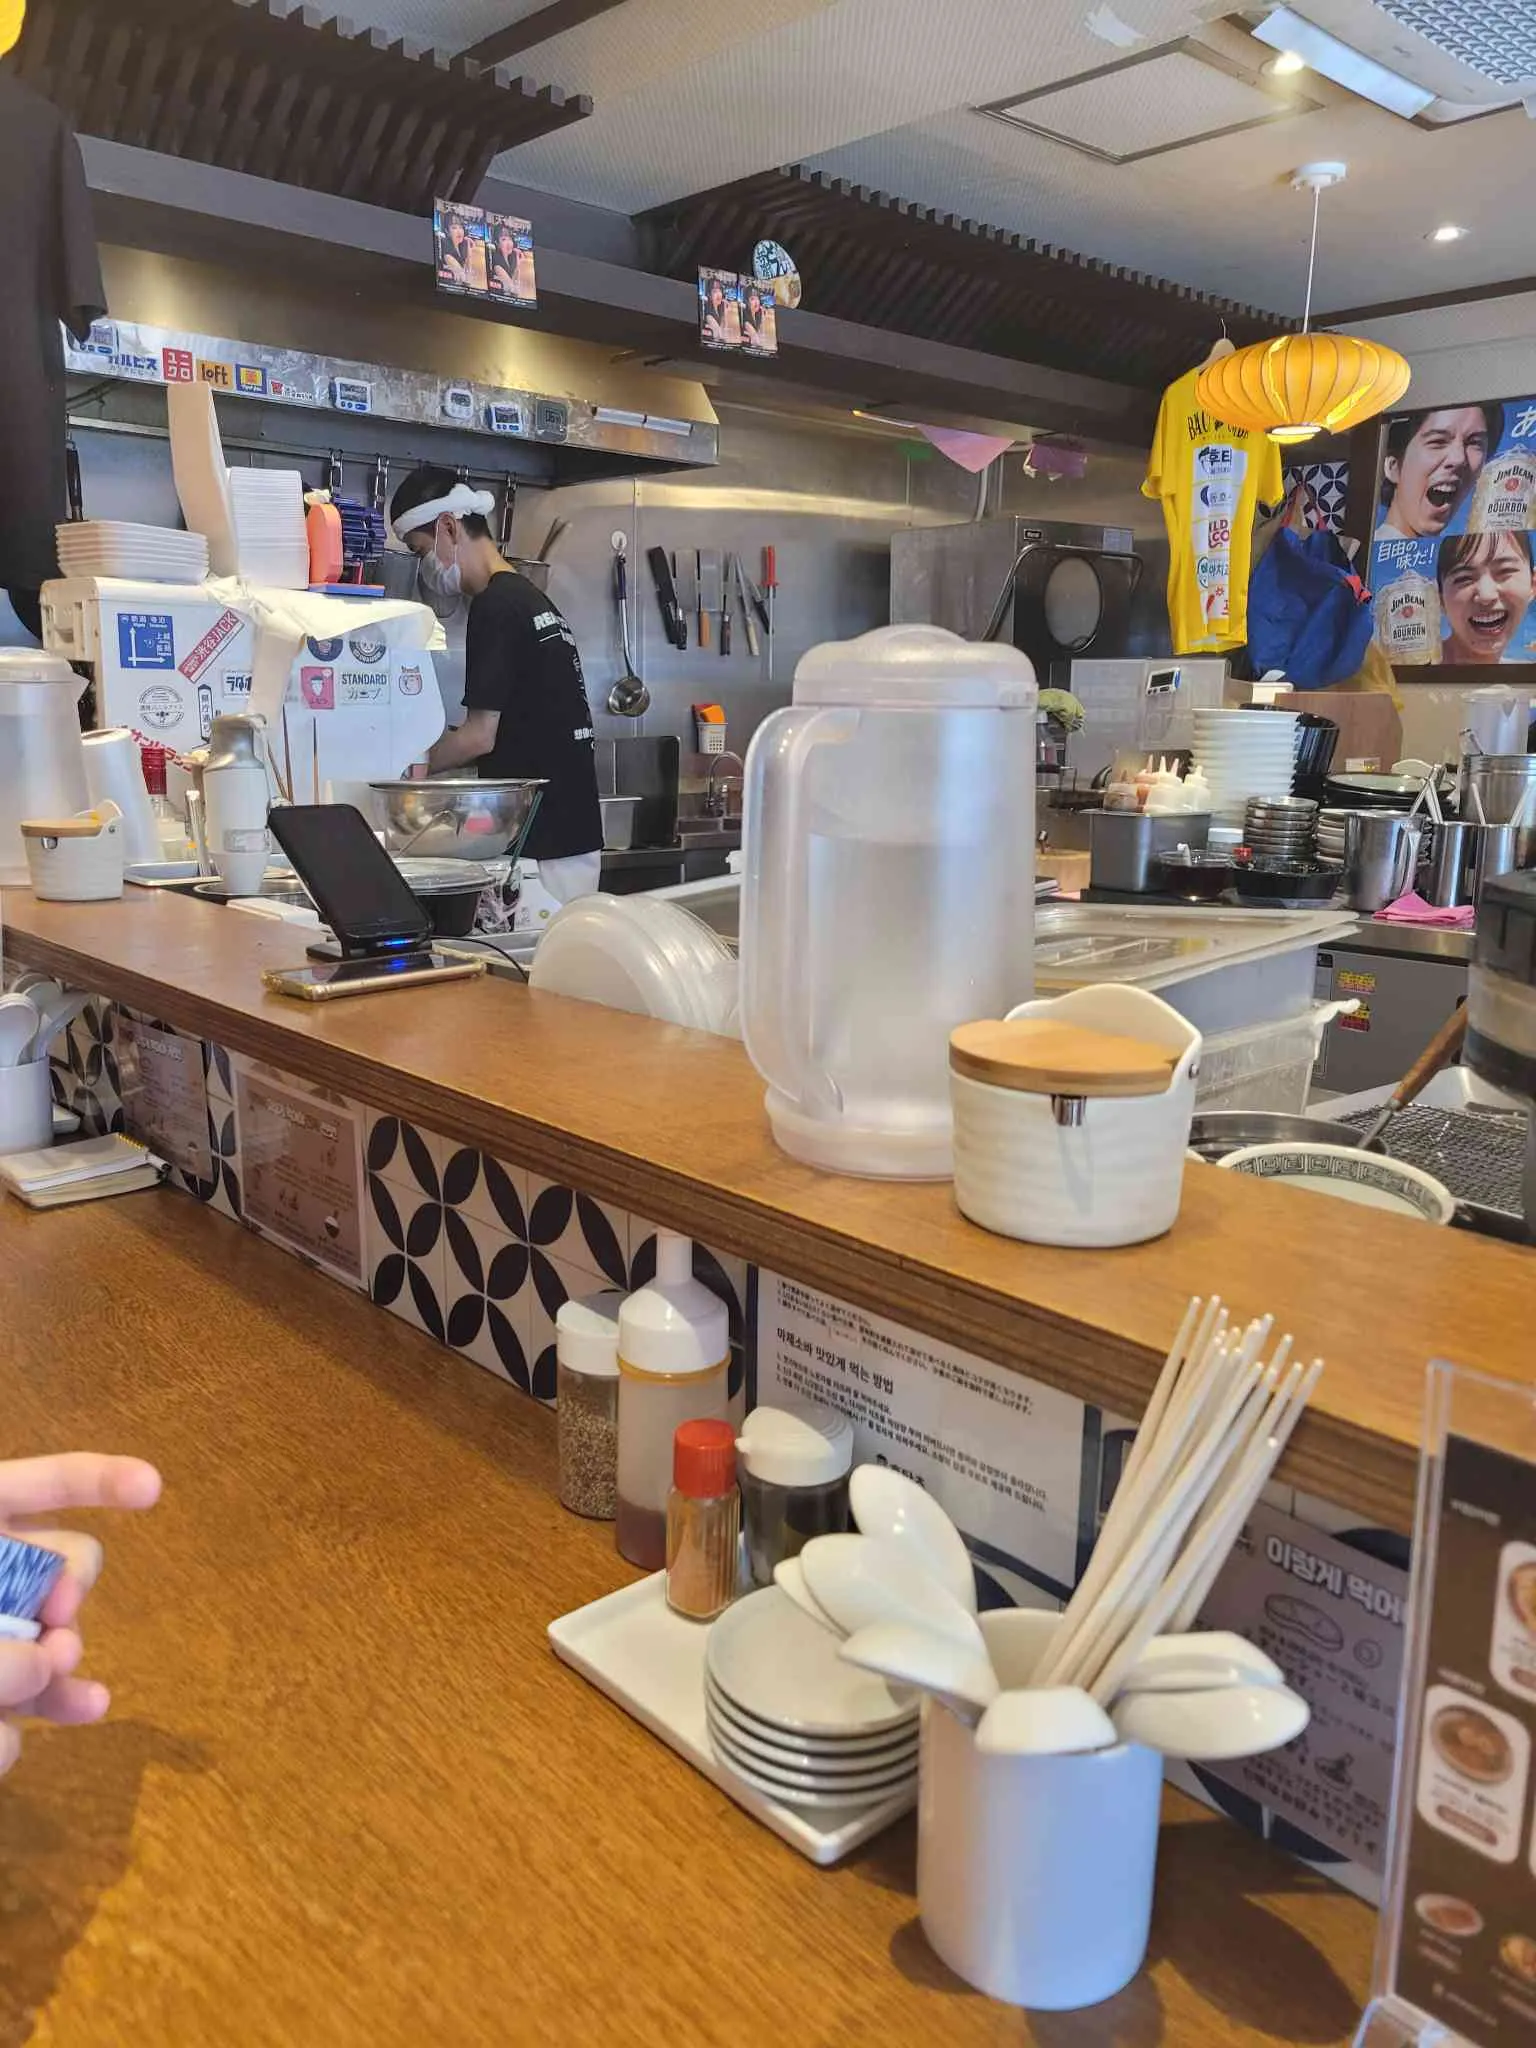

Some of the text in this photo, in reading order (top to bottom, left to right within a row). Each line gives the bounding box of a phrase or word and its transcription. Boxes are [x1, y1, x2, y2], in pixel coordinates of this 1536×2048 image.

[1487, 502, 1527, 513] BOURBON
[1377, 540, 1418, 563] 自由の
[1392, 626, 1426, 640] BOURBON
[341, 674, 387, 685] STANDARD
[815, 1345, 846, 1373] 맛있게
[849, 1360, 870, 1384] 먹는
[873, 1372, 894, 1395] 방법
